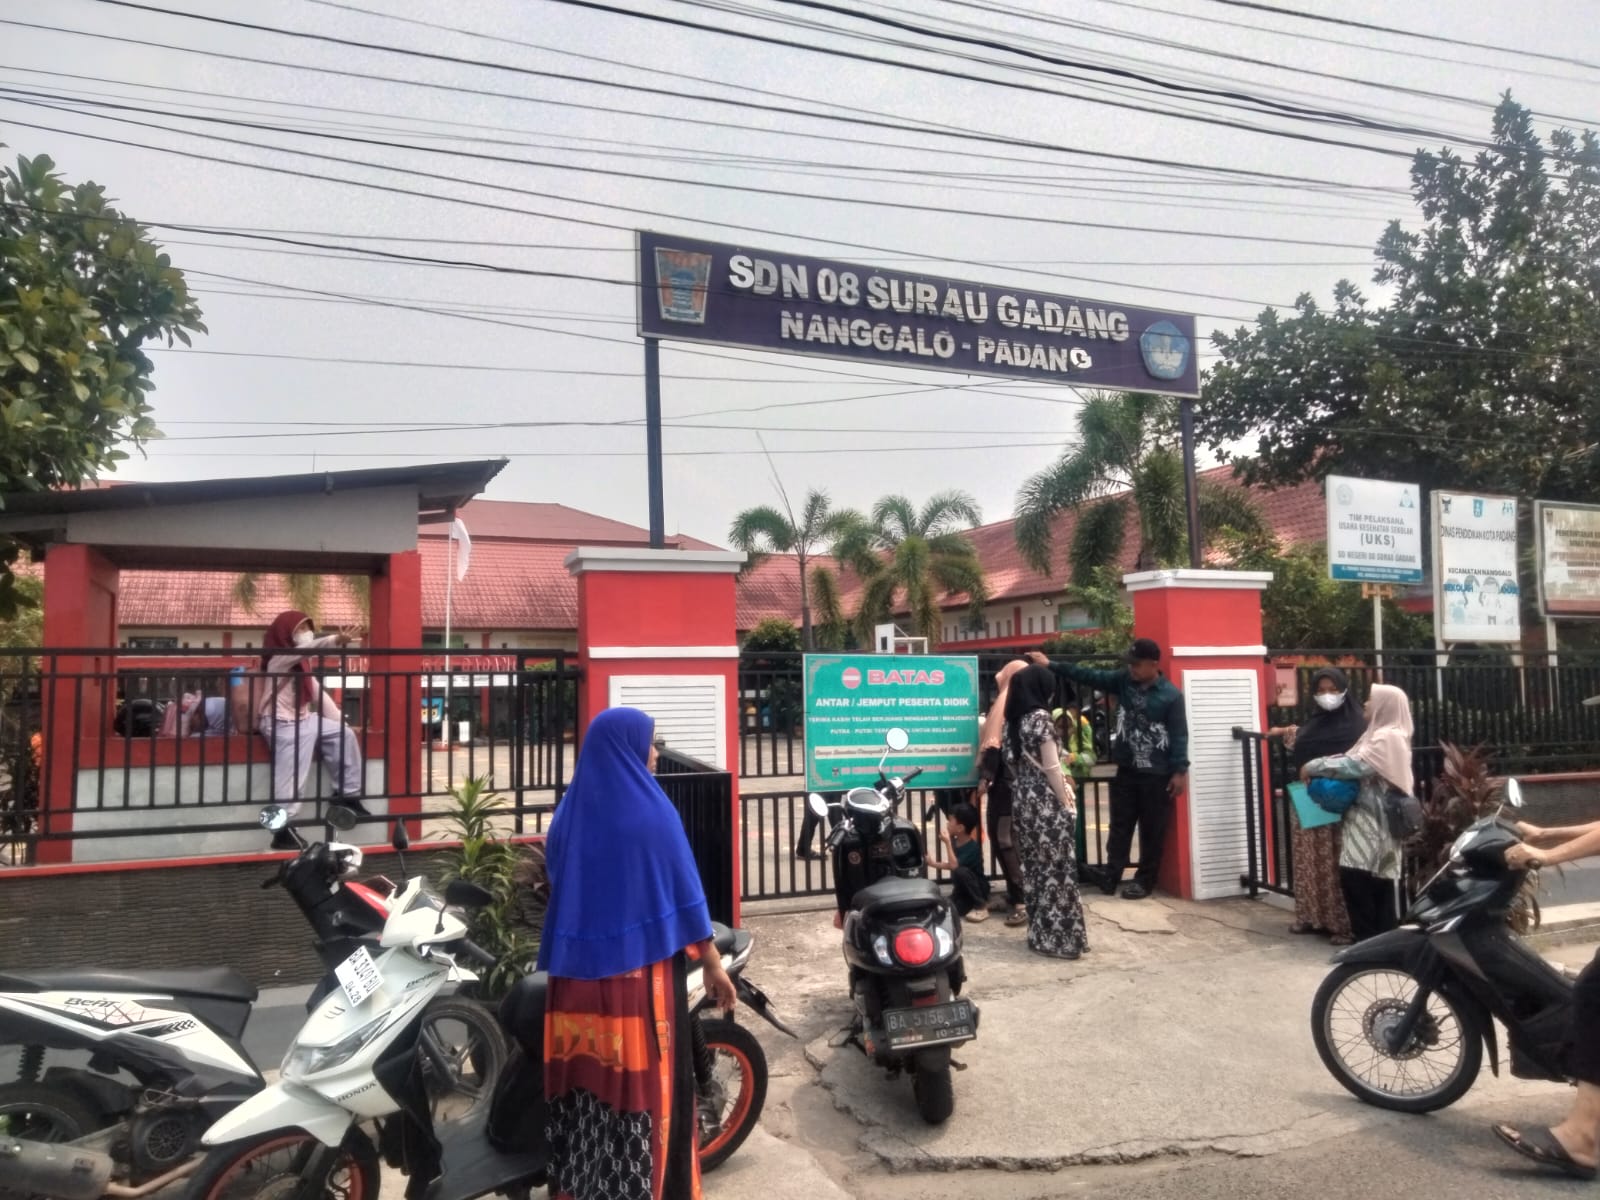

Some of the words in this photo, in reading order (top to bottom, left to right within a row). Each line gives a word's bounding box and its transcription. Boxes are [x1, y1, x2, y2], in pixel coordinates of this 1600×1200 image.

[728, 255, 809, 299] SDN
[817, 268, 860, 306] 08
[866, 277, 989, 324] SURAU
[997, 295, 1130, 342] GADANG
[780, 310, 956, 359] NANGGALO
[978, 336, 1093, 373] PADANG
[1361, 533, 1395, 548] (UKS)
[867, 669, 946, 686] BATAS
[816, 698, 850, 707] ANTAR
[857, 698, 897, 707] JEMPUT
[899, 698, 942, 707] PESERTA
[943, 698, 969, 707] DIDIK
[337, 1080, 377, 1102] HONDA
